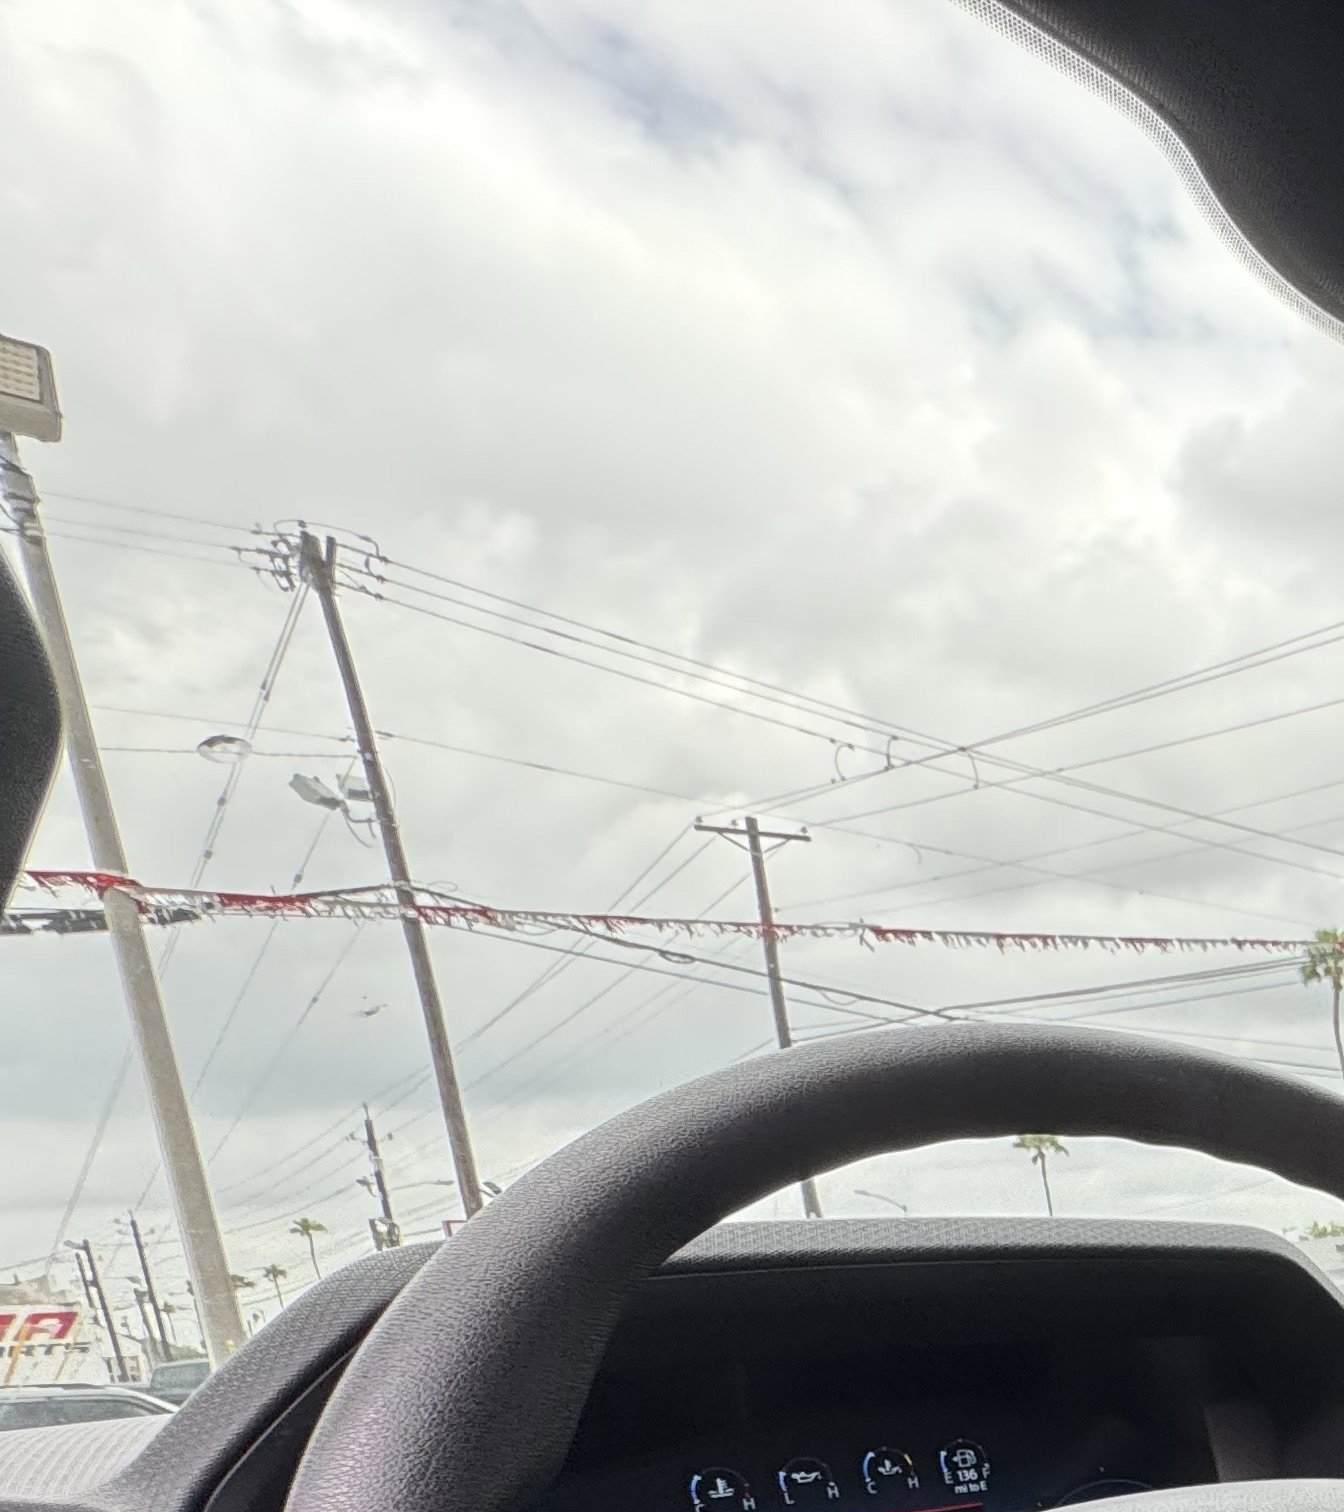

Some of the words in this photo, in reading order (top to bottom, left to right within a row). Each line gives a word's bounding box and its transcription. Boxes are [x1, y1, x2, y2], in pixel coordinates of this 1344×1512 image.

[908, 1476, 919, 1489] H
[957, 1469, 979, 1482] 136
[827, 1485, 840, 1499] H
[954, 1484, 968, 1494] mi
[969, 1483, 979, 1493] to
[979, 1480, 988, 1491] E
[743, 1497, 756, 1511] H
